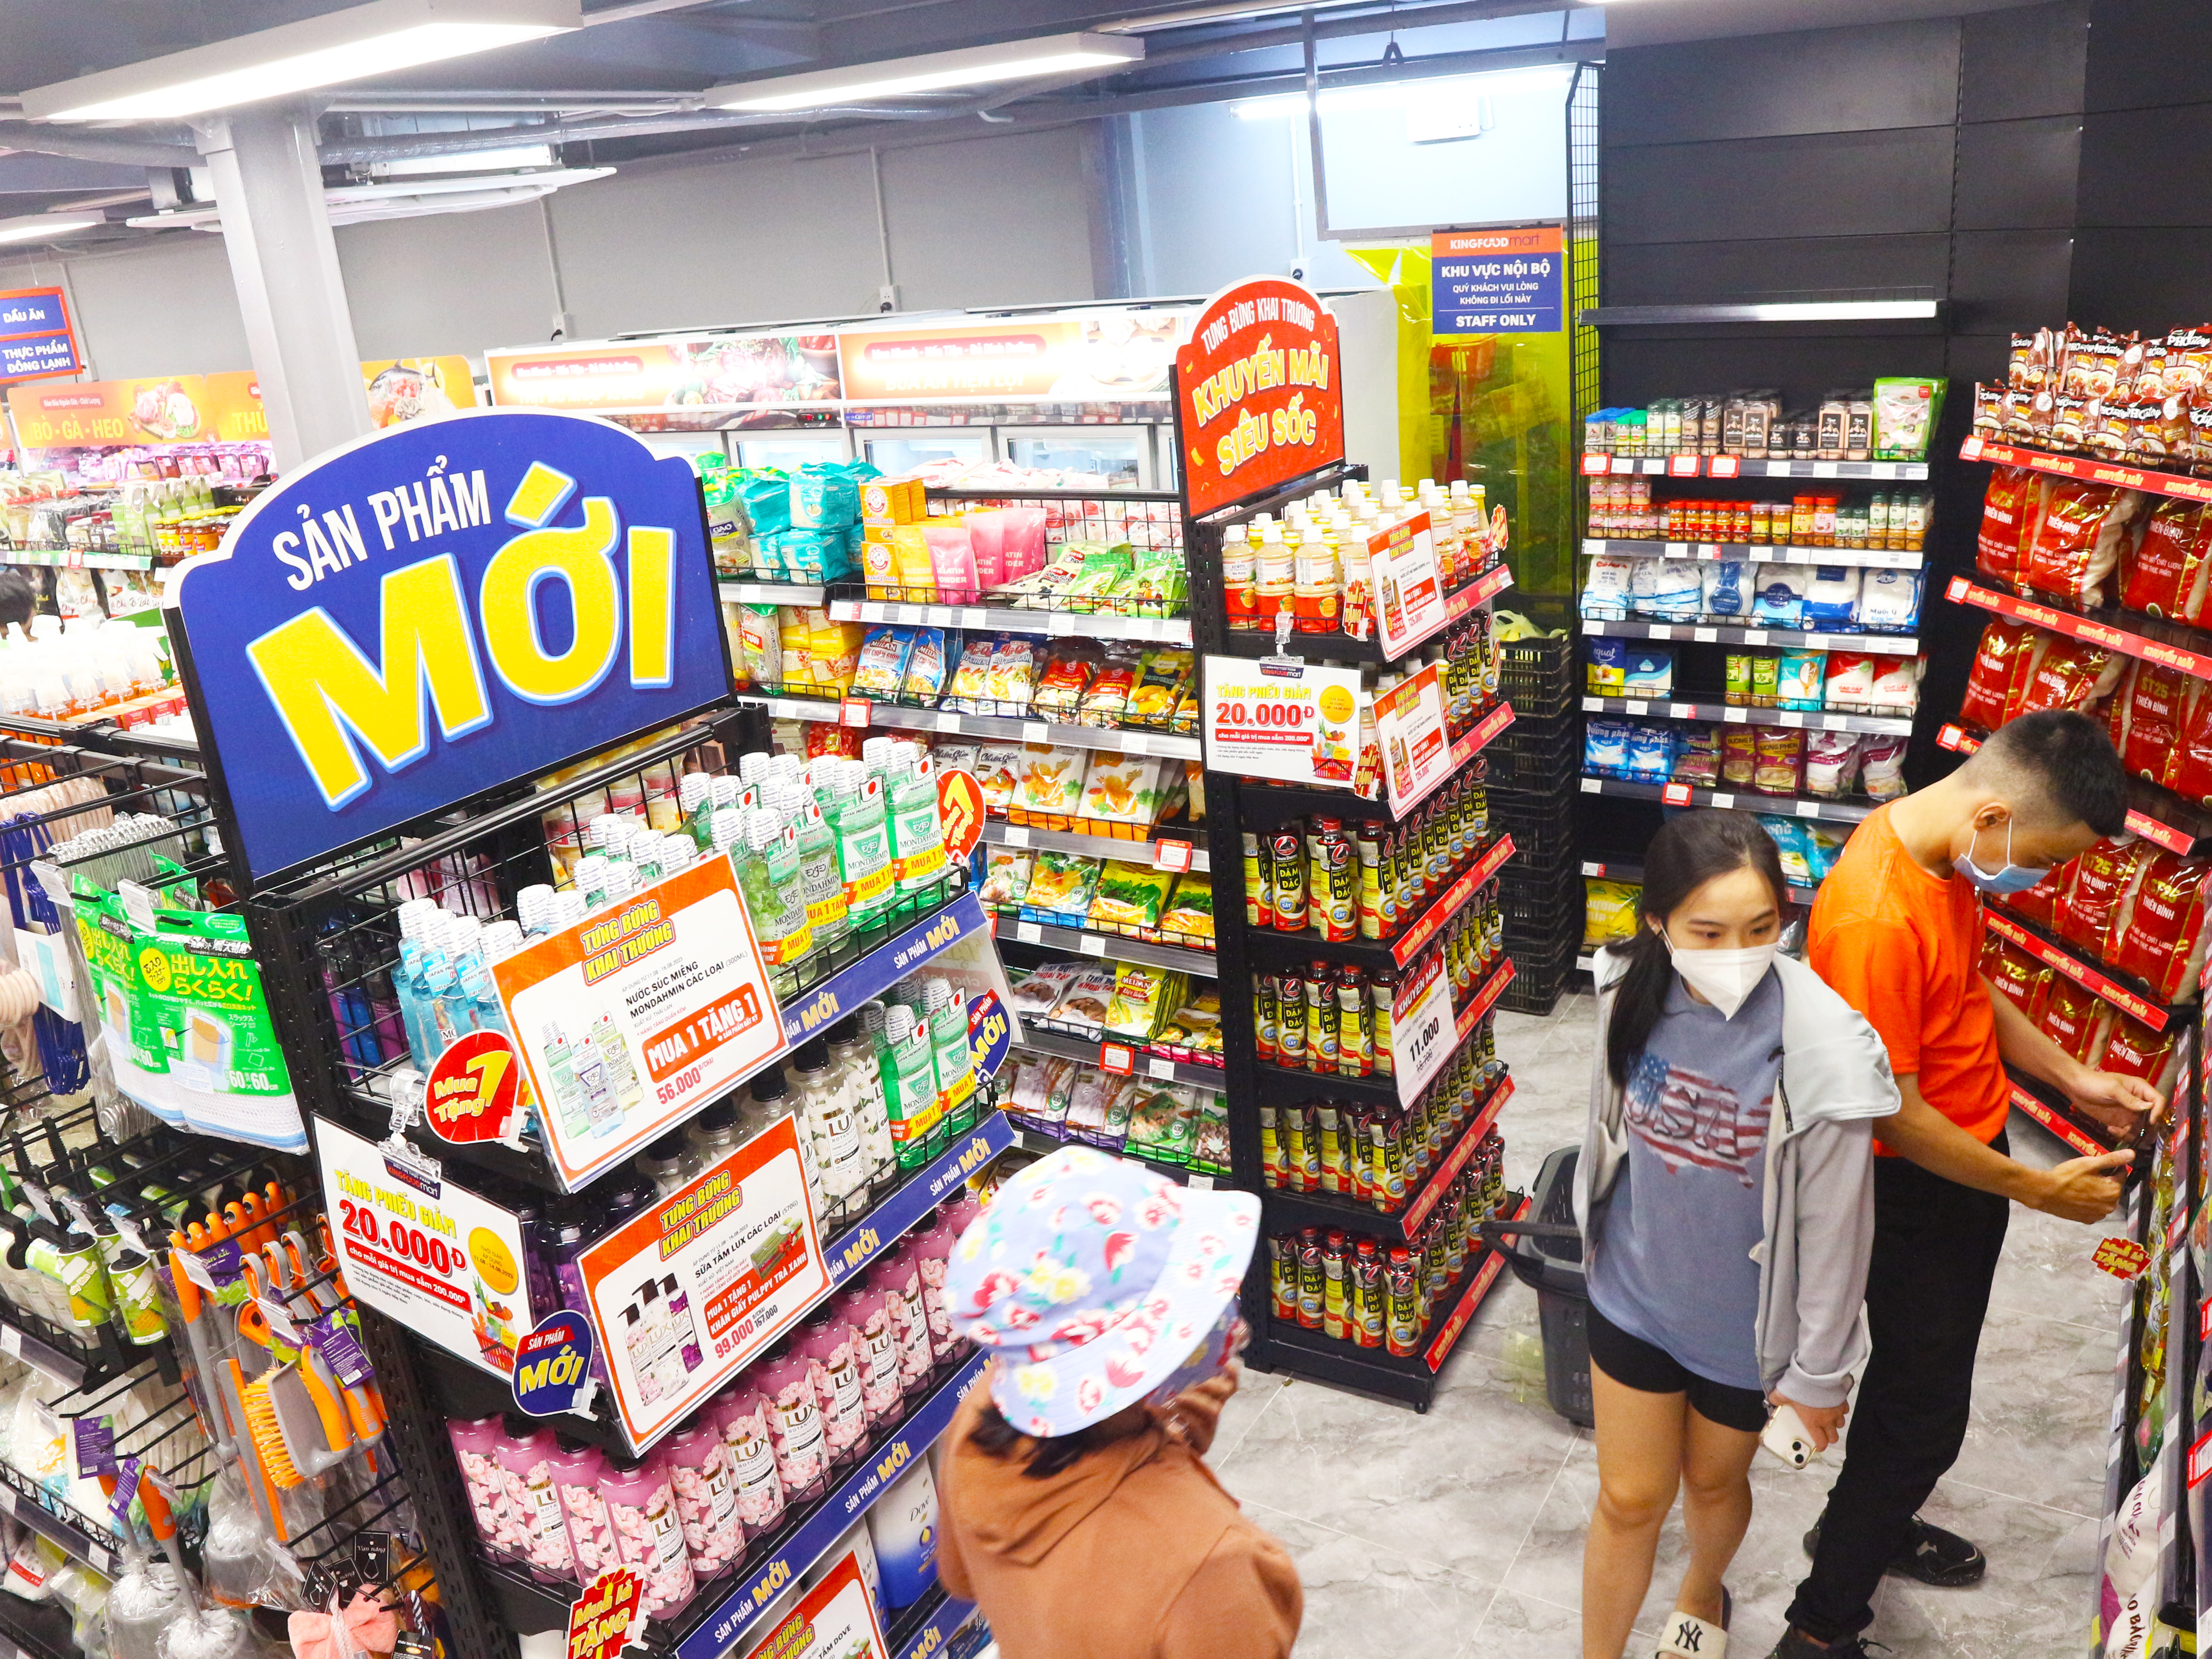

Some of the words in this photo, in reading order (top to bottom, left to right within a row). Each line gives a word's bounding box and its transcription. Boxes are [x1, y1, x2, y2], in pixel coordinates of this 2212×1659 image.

[1442, 265, 1469, 277] KHU
[1472, 263, 1500, 279] VỰC
[1504, 259, 1527, 278] NỘI
[1531, 258, 1551, 277] BỘ
[1453, 283, 1469, 293] QUÝ
[1471, 282, 1499, 292] KHÁCH
[1516, 281, 1539, 290] LÒNG
[1460, 295, 1488, 304] KHÔNG
[1490, 296, 1498, 304] ĐI
[1500, 293, 1513, 303] LỐI
[1515, 294, 1531, 303] NÀY
[29, 308, 45, 321] ĂN
[1228, 300, 1254, 334] BỪNG
[1257, 298, 1278, 322] KHAI
[1281, 298, 1314, 332] TRƯƠNG
[1456, 315, 1497, 327] STAFF
[1500, 314, 1536, 326] ONLY
[2, 346, 34, 361] THỰC
[35, 339, 68, 356] PHẨM
[7, 360, 40, 374] ĐÔNG
[41, 357, 71, 371] LẠNH
[1192, 332, 1285, 428] KHUYẾN
[1289, 340, 1329, 390] MÃI
[32, 413, 53, 441] BÒ
[62, 412, 84, 440] GÀ
[92, 418, 124, 439] HEO
[1217, 408, 1268, 475] SIÊU
[1272, 391, 1316, 445] SỐC
[271, 504, 369, 591] SẢN
[367, 454, 492, 552] PHẨM
[245, 460, 676, 812] MỚI
[1216, 683, 1245, 702] TẶNG
[1248, 683, 1280, 699] PHIẾU
[1282, 684, 1311, 699] GIẢM
[2136, 695, 2152, 711] THIÊN
[2152, 700, 2168, 715] BÌNH
[2141, 676, 2168, 699] ST25
[1229, 731, 1240, 739] mỗi
[1241, 733, 1250, 741] giá
[1271, 733, 1284, 741] sắm
[900, 829, 941, 848] MONDAHMIN
[942, 806, 962, 840] Mua
[950, 809, 974, 847] Tặng
[848, 849, 889, 870] MONDAHMIN
[581, 919, 620, 954] TƯNG
[620, 901, 659, 935] BỪNG
[894, 950, 908, 970] SẢN
[907, 938, 927, 962] PHẨM
[926, 914, 960, 951] MỚI
[171, 954, 249, 980] 出し入れ
[584, 948, 620, 983] KHAI
[619, 921, 674, 963] TRƯƠNG
[626, 986, 651, 1007] NƯỚC
[651, 975, 670, 992] SÚC
[670, 961, 698, 982] MIỆNG
[630, 982, 685, 1019] MONDAHMIN
[686, 972, 704, 987] CÁC
[705, 961, 724, 977] LOẠI
[1397, 974, 1425, 1017] KHUYẾN
[1426, 961, 1439, 985] MÃI
[663, 1003, 673, 1014] LAN
[970, 1009, 982, 1026] SẢN
[979, 994, 994, 1015] PHẨM
[647, 1033, 688, 1072] MUA
[686, 1024, 699, 1048] 1
[697, 999, 745, 1042] TẶNG
[744, 992, 757, 1015] 1
[723, 1030, 733, 1039] SẢN
[732, 1021, 744, 1034] PHẨM
[971, 1012, 1007, 1070] MỚI
[1409, 1017, 1440, 1062] 11.000
[434, 1076, 478, 1099] Mua
[656, 1067, 701, 1105] 56.000
[434, 1097, 486, 1123] Tặng
[829, 1111, 854, 1137] LUX
[334, 1169, 373, 1202] TẶNG
[373, 1185, 417, 1220] PHIẾU
[418, 1205, 457, 1238] GIẢM
[661, 1195, 695, 1231] TƯNG
[697, 1170, 730, 1208] BỪNG
[661, 1221, 692, 1258] KHAI
[692, 1188, 741, 1234] TRƯƠNG
[695, 1262, 712, 1278] SỮA
[712, 1250, 730, 1266] TẮM
[731, 1236, 746, 1253] LUX
[747, 1225, 763, 1240] CÁC
[763, 1211, 781, 1227] LOẠI
[782, 1200, 798, 1216] (570G)
[349, 1247, 363, 1259] cho
[363, 1251, 377, 1265] mỗi
[378, 1260, 389, 1272] giá
[389, 1263, 398, 1276] trị
[399, 1268, 416, 1280] mua
[416, 1274, 433, 1290] sắm
[707, 1302, 723, 1321] MUA
[722, 1298, 728, 1308] 1
[727, 1285, 747, 1304] TẶNG
[746, 1280, 752, 1289] 1
[710, 1313, 731, 1335] KHĂN
[731, 1298, 747, 1319] GIẤY
[747, 1280, 773, 1305] PULPPY
[774, 1266, 789, 1284] TRÀ
[788, 1252, 806, 1273] XANH
[755, 1304, 779, 1328] 157.000
[528, 1336, 543, 1351] SẢN
[543, 1327, 565, 1348] PHẨM
[715, 1319, 754, 1359] 99.000
[519, 1345, 586, 1396] MỚI
[785, 1398, 818, 1428] LUX
[845, 1494, 858, 1514] SẢN
[858, 1476, 878, 1503] PHẨM
[876, 1440, 912, 1483] MỚI
[910, 1494, 930, 1522] Dove
[573, 1595, 613, 1630] Mua
[715, 1622, 731, 1644] SẢN
[730, 1599, 754, 1628] PHẨM
[752, 1558, 792, 1607] MỚI
[571, 1607, 630, 1659] TẶNG
